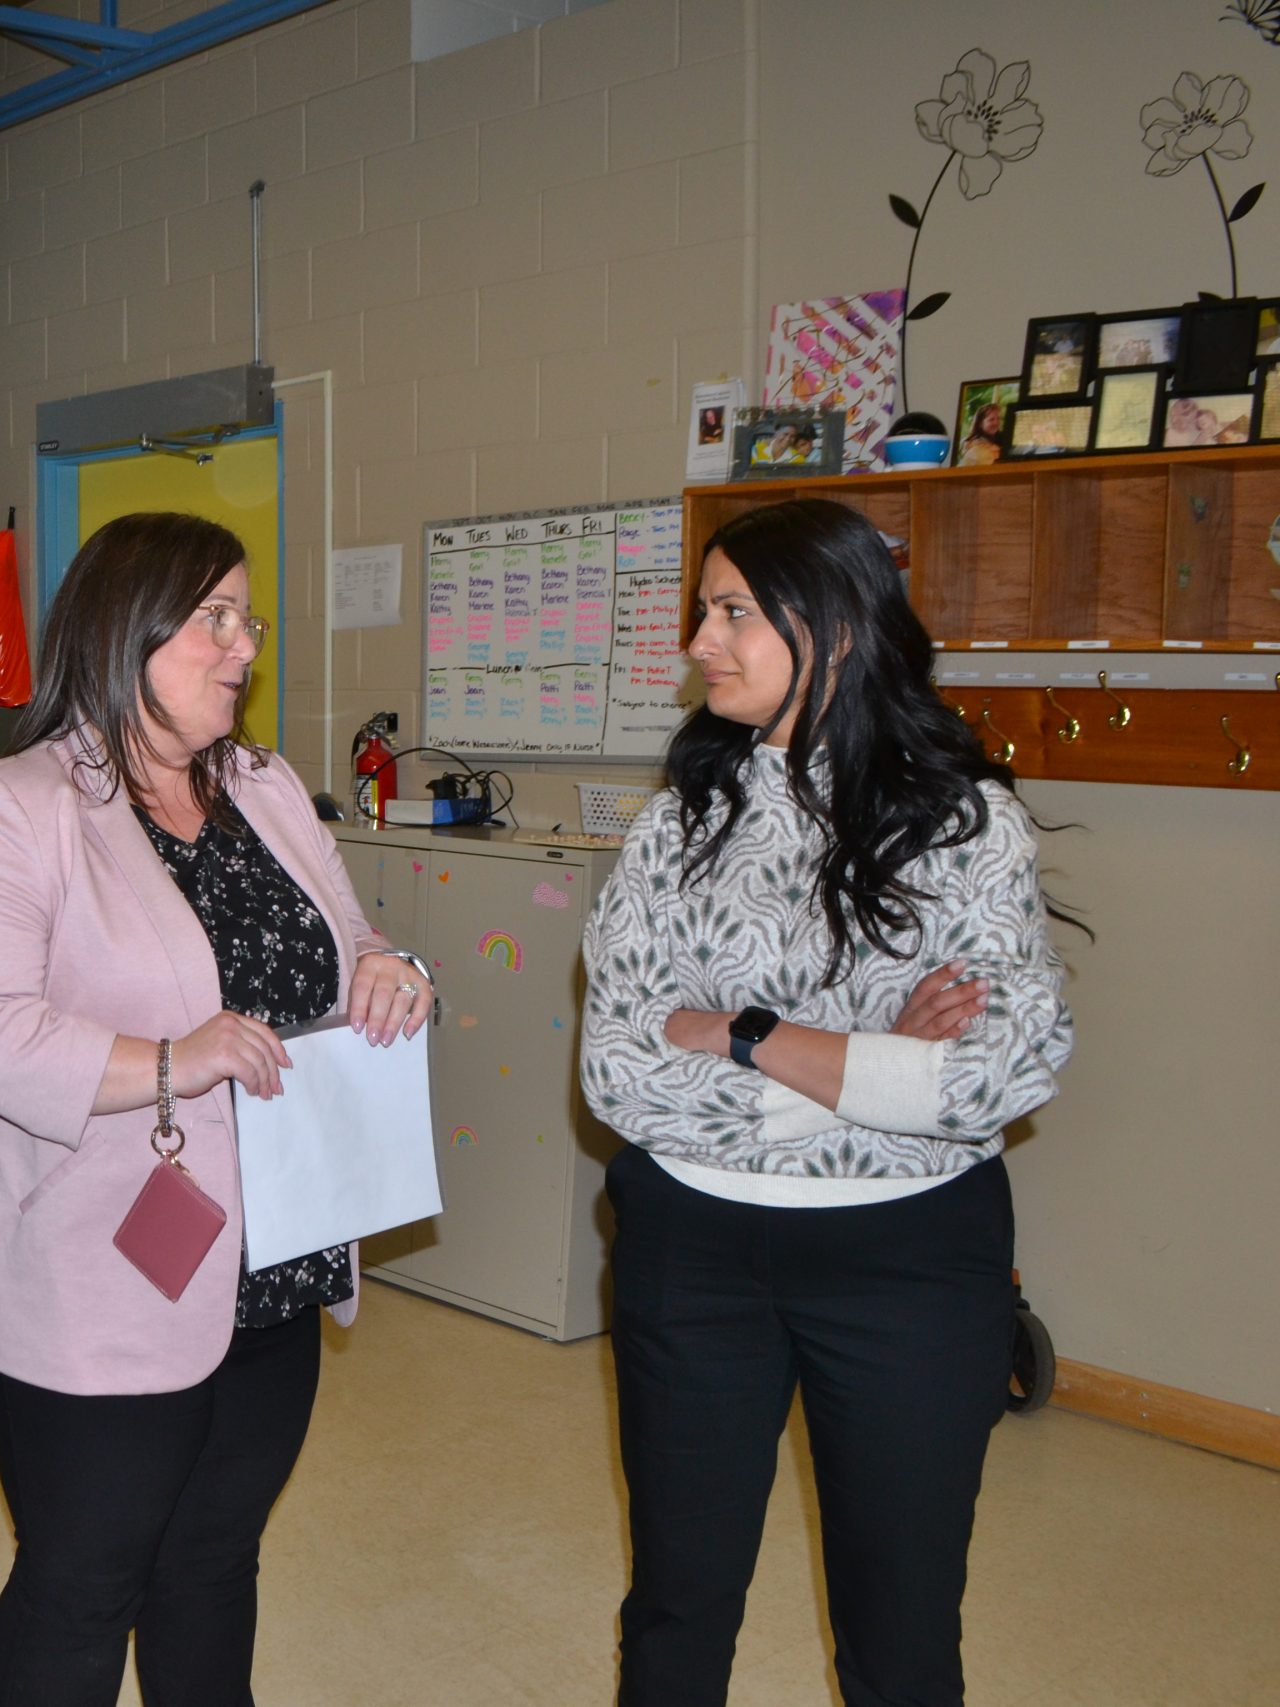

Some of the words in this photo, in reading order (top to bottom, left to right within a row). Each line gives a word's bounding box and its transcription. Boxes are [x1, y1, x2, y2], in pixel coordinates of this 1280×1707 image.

[466, 528, 491, 544] TUES
[505, 524, 528, 541] WED
[582, 516, 602, 534] FRI
